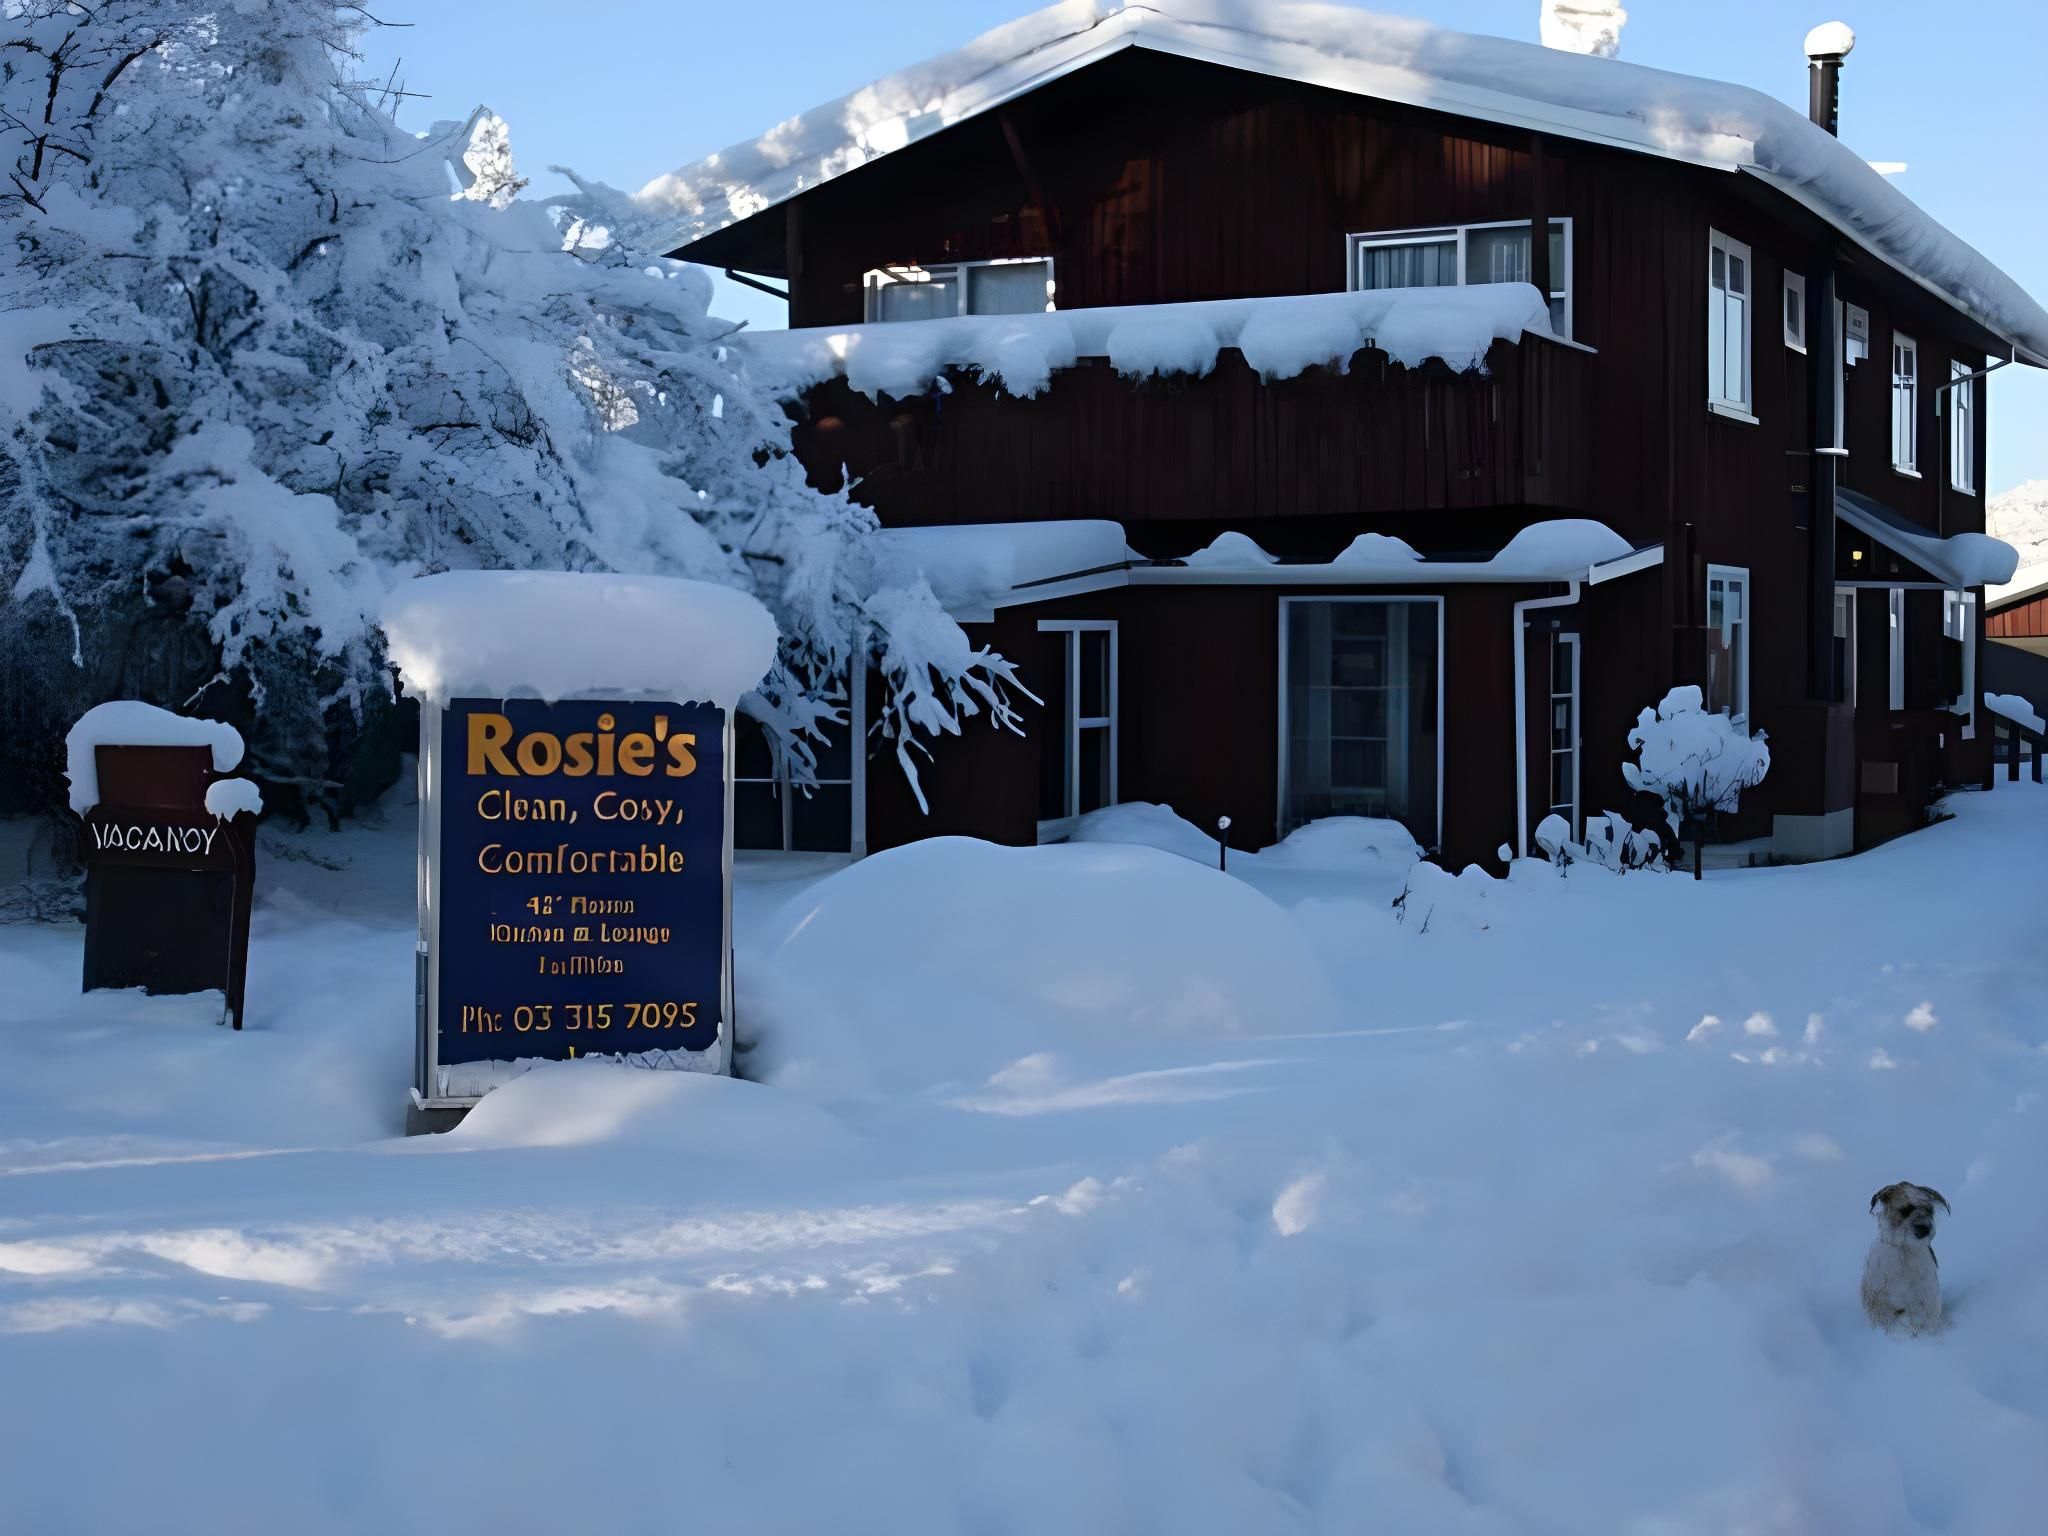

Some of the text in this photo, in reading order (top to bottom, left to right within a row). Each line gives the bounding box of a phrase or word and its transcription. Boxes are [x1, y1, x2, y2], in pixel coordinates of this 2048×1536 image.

[466, 712, 698, 778] Rosie's
[513, 1004, 553, 1032] 03
[564, 1003, 614, 1030] 315
[623, 1001, 698, 1029] 7095
